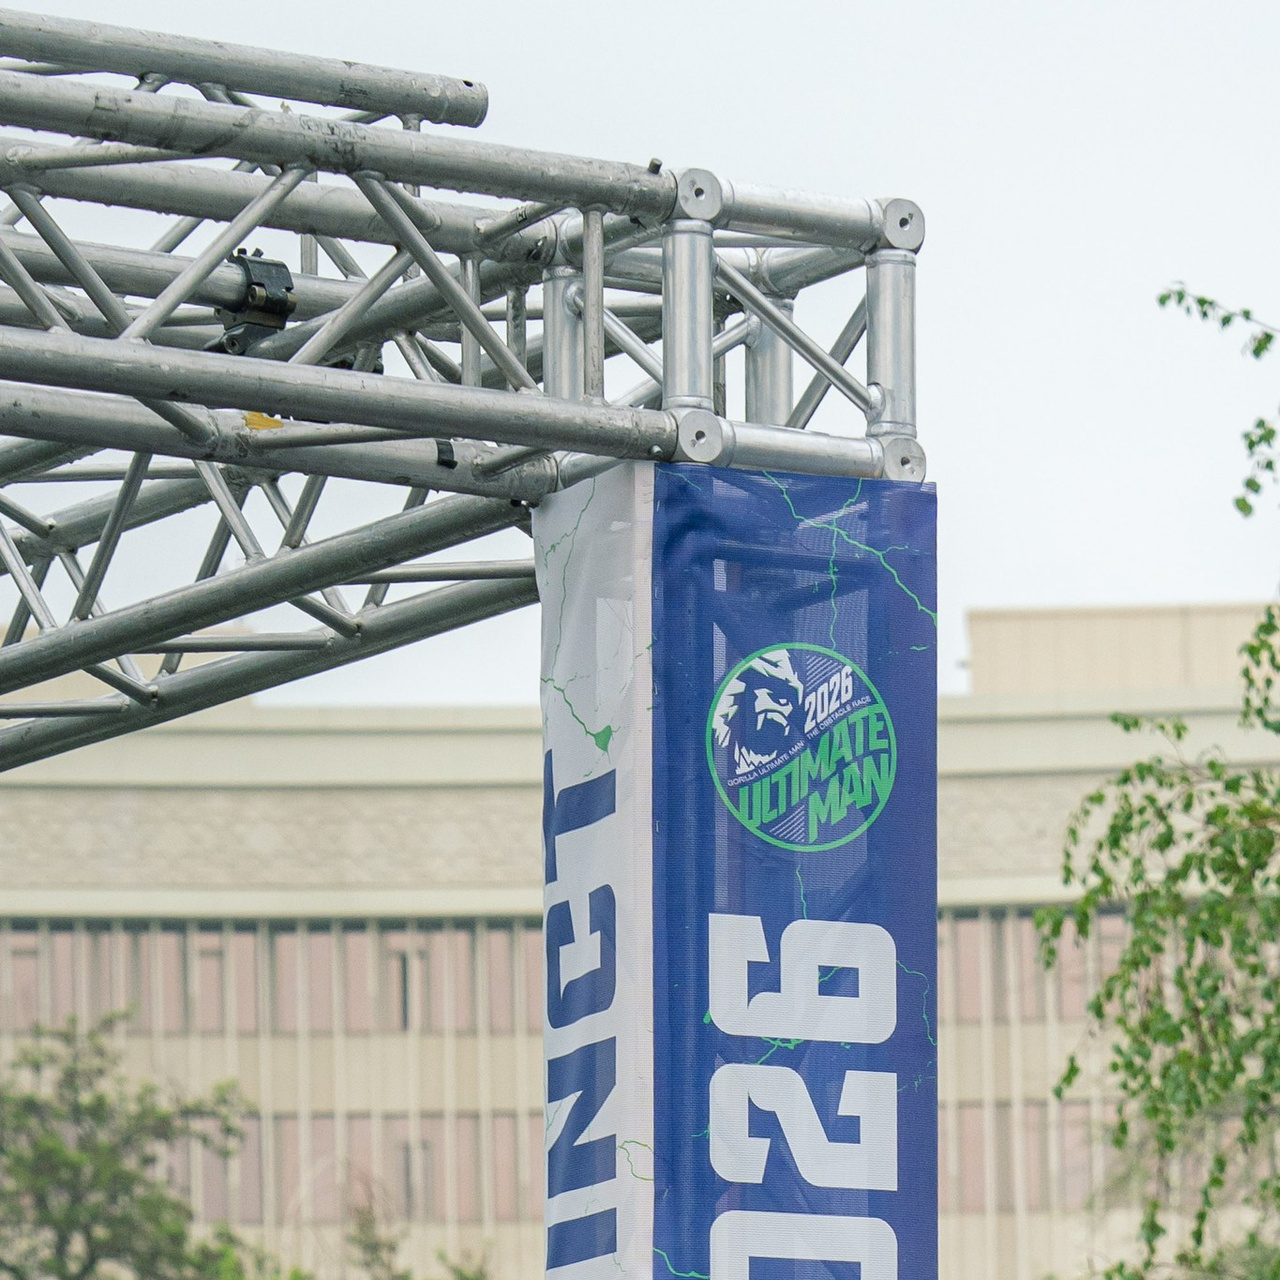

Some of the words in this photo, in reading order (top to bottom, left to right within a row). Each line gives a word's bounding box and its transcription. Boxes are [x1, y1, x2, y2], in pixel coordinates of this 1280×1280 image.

[804, 666, 853, 734] 2026
[806, 729, 820, 740] THE
[819, 705, 852, 731] OBSTACLE
[852, 695, 872, 708] RACE
[727, 772, 758, 787] GORILLA
[759, 752, 789, 776] ULTIMATE
[738, 705, 888, 828] ULTIMATE
[809, 754, 892, 844] MAN
